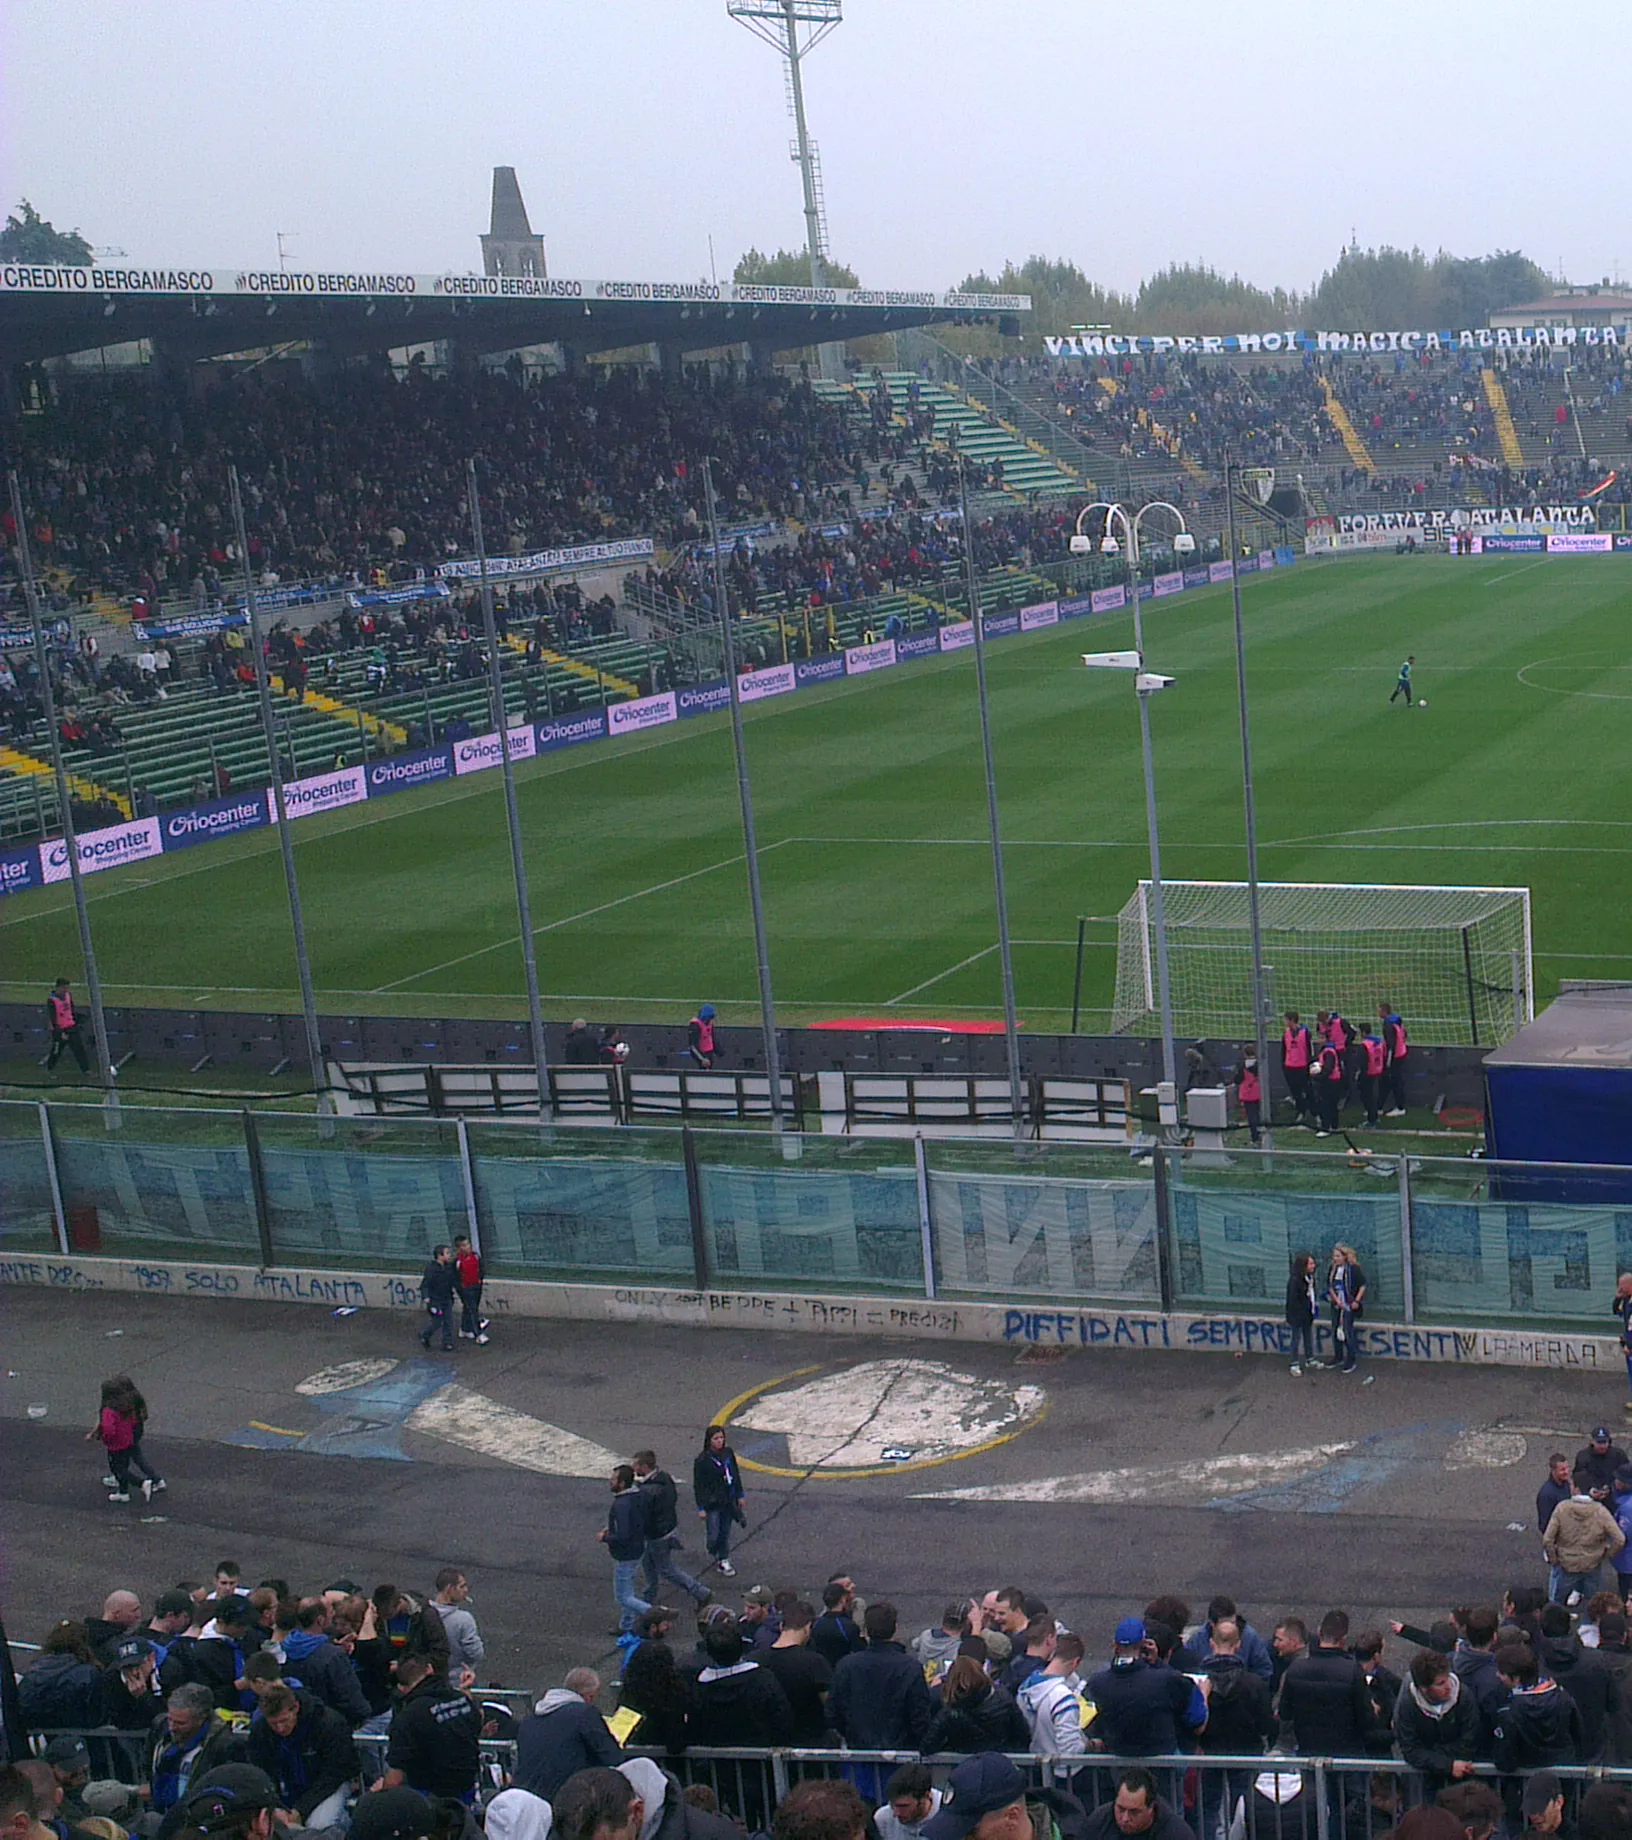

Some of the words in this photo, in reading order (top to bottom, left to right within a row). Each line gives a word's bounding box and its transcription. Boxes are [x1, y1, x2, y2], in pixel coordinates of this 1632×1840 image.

[4, 266, 88, 289] CREDITO
[91, 268, 214, 292] BERGAMASCO
[248, 272, 314, 292] CREDITO
[317, 273, 416, 294] BERGAMASCO
[444, 277, 498, 295] CREDITO
[501, 279, 582, 297] BERGAMASCO
[604, 283, 649, 298] CREDITO
[652, 284, 720, 300] BERGAMASCO
[738, 287, 777, 302] CREDITO
[778, 288, 837, 303] BERGAMASCO
[852, 290, 885, 304] CREDITO
[886, 291, 935, 306] BERGAMASCO
[1044, 335, 1142, 356] VINCI
[1151, 335, 1224, 353] PER
[1236, 331, 1298, 352] NOI
[1316, 330, 1441, 351] MAGICA
[1459, 326, 1619, 348] ATALANTA
[1551, 537, 1607, 548] Oriocenter
[680, 686, 731, 708] Oriocente
[614, 700, 671, 723] Oriocenter
[540, 717, 603, 743] Oriocenter
[371, 754, 447, 785] Oriocenter
[167, 801, 260, 838] Oriocenter
[50, 830, 150, 867] Oiocenter
[129, 1266, 173, 1290] 1907
[185, 1272, 239, 1292] SOLO
[253, 1273, 368, 1306] ATALANTA
[1003, 1308, 1171, 1348] DIFFIDATI
[1187, 1319, 1291, 1355] SEMPRE
[1316, 1326, 1461, 1361] PESENTI
